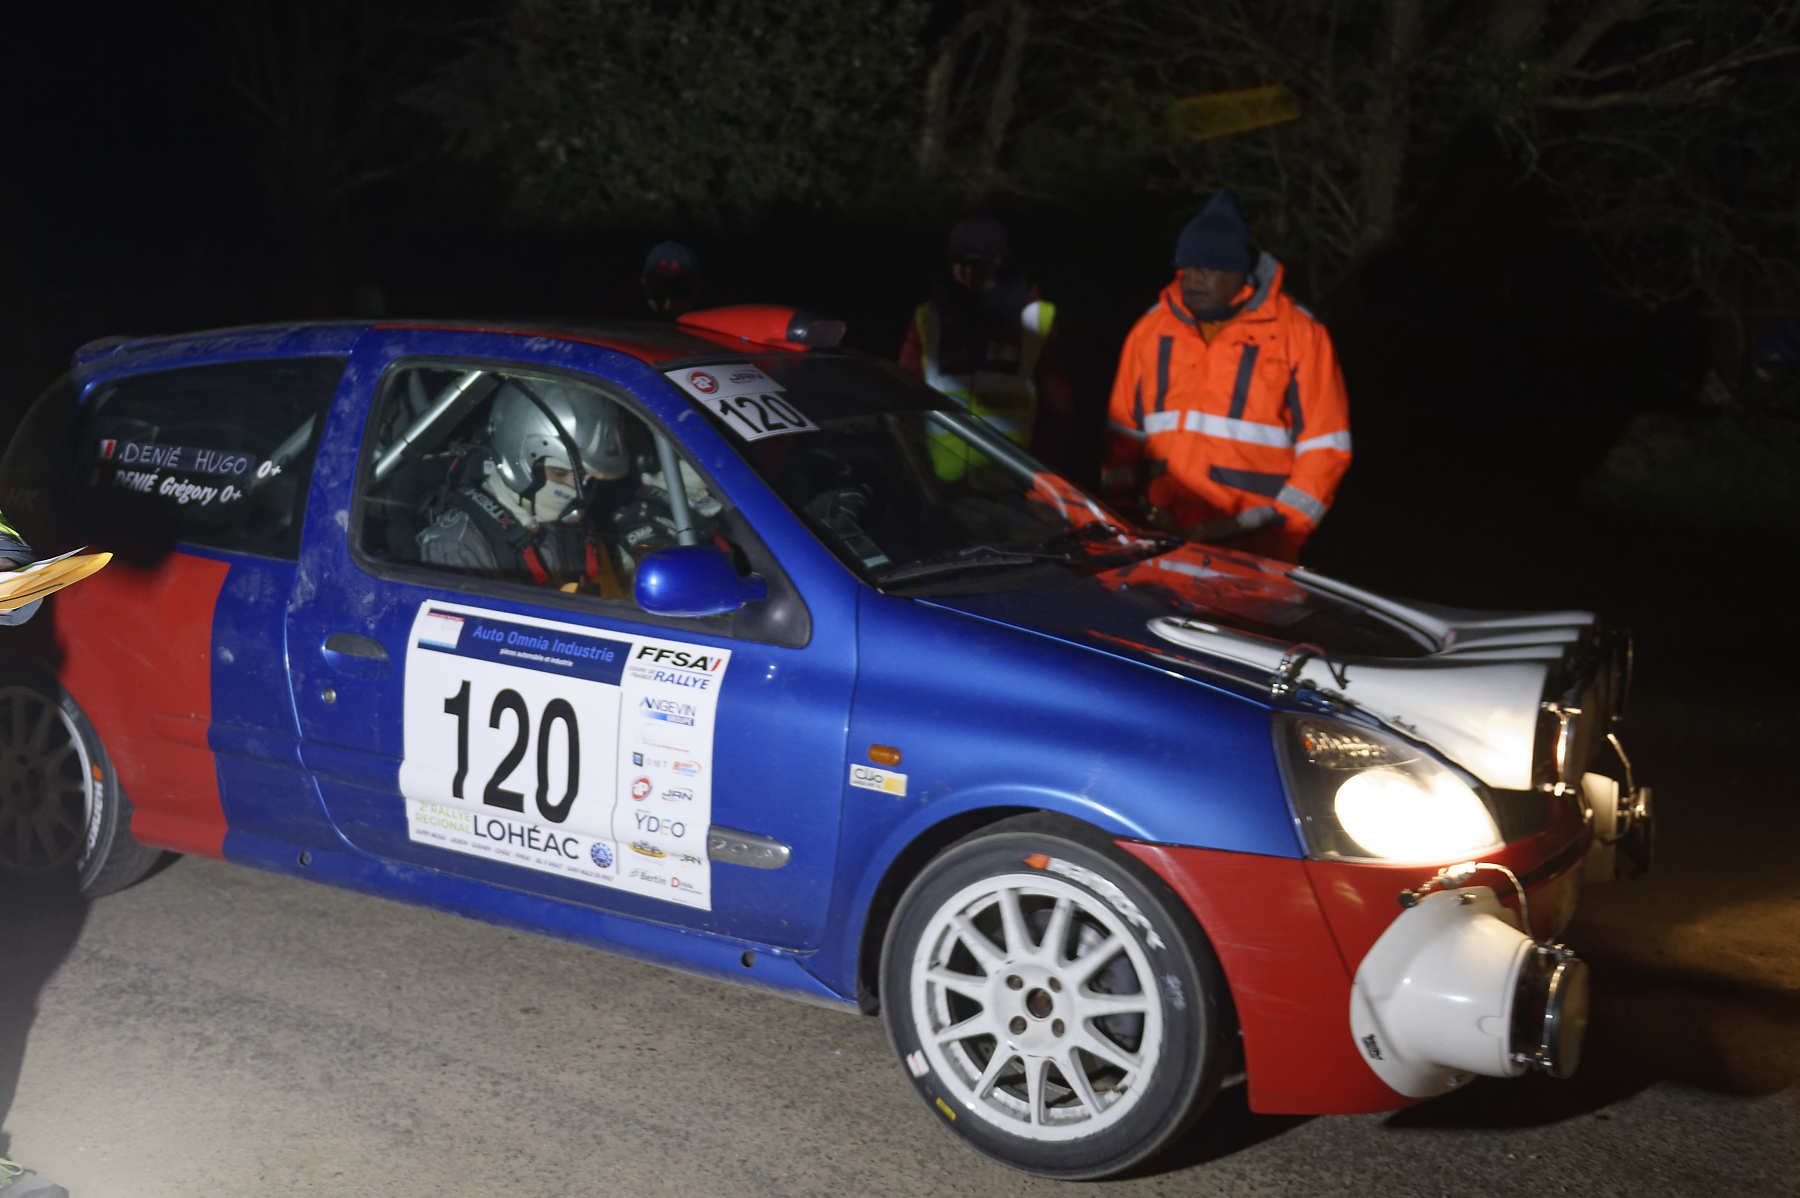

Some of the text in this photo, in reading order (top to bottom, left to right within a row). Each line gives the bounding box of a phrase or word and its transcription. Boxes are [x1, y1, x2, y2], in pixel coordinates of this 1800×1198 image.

[720, 394, 807, 434] 120
[194, 449, 248, 475] HUGO
[160, 476, 218, 506] Grégory
[472, 624, 615, 662] Auto Omnia Industrie
[636, 646, 708, 671] FFSA
[654, 671, 710, 690] RALLYE
[444, 679, 580, 824] 120
[473, 814, 580, 860] LOHÉAC
